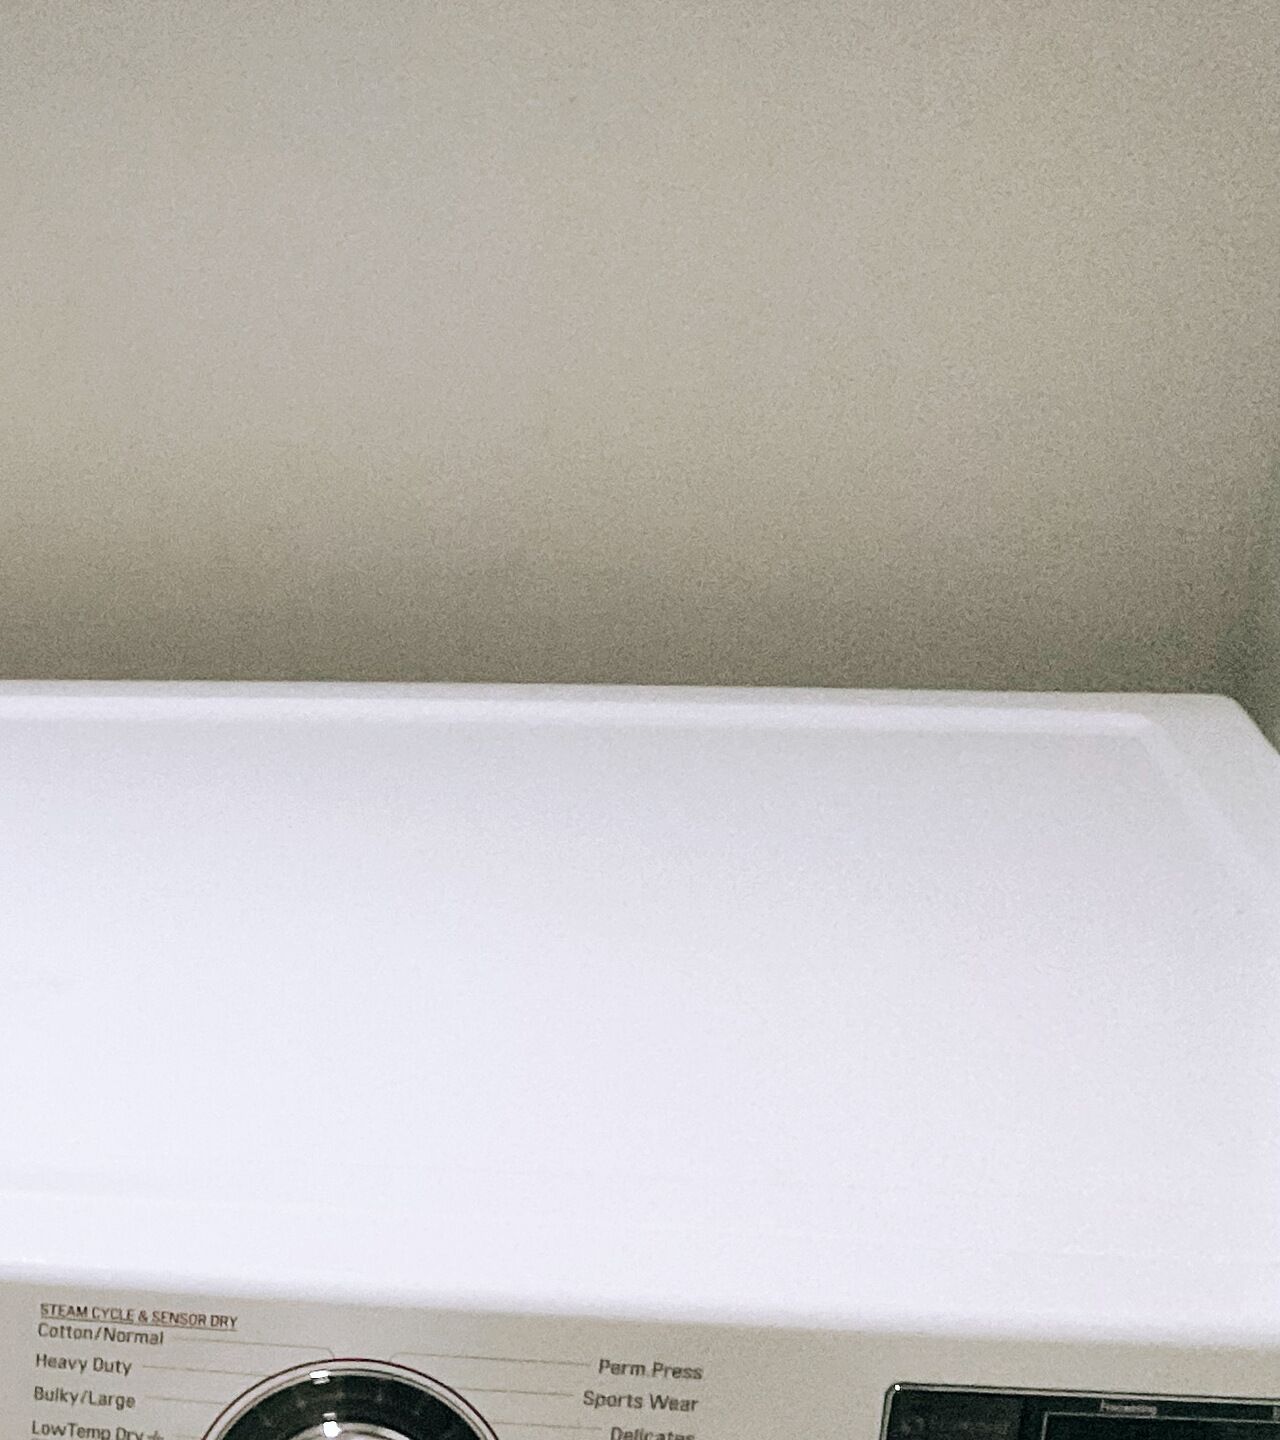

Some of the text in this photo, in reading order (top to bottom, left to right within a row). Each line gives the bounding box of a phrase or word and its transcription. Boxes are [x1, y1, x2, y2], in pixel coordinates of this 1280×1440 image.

[40, 1302, 239, 1330] STEAM CYCLE & SENSOR DRY
[38, 1322, 164, 1346] Cotton/Normal
[35, 1352, 133, 1376] Heavy Duty
[652, 1360, 704, 1381] Press
[33, 1385, 136, 1411] Bulky/Large
[583, 1389, 699, 1413] Sports Wear
